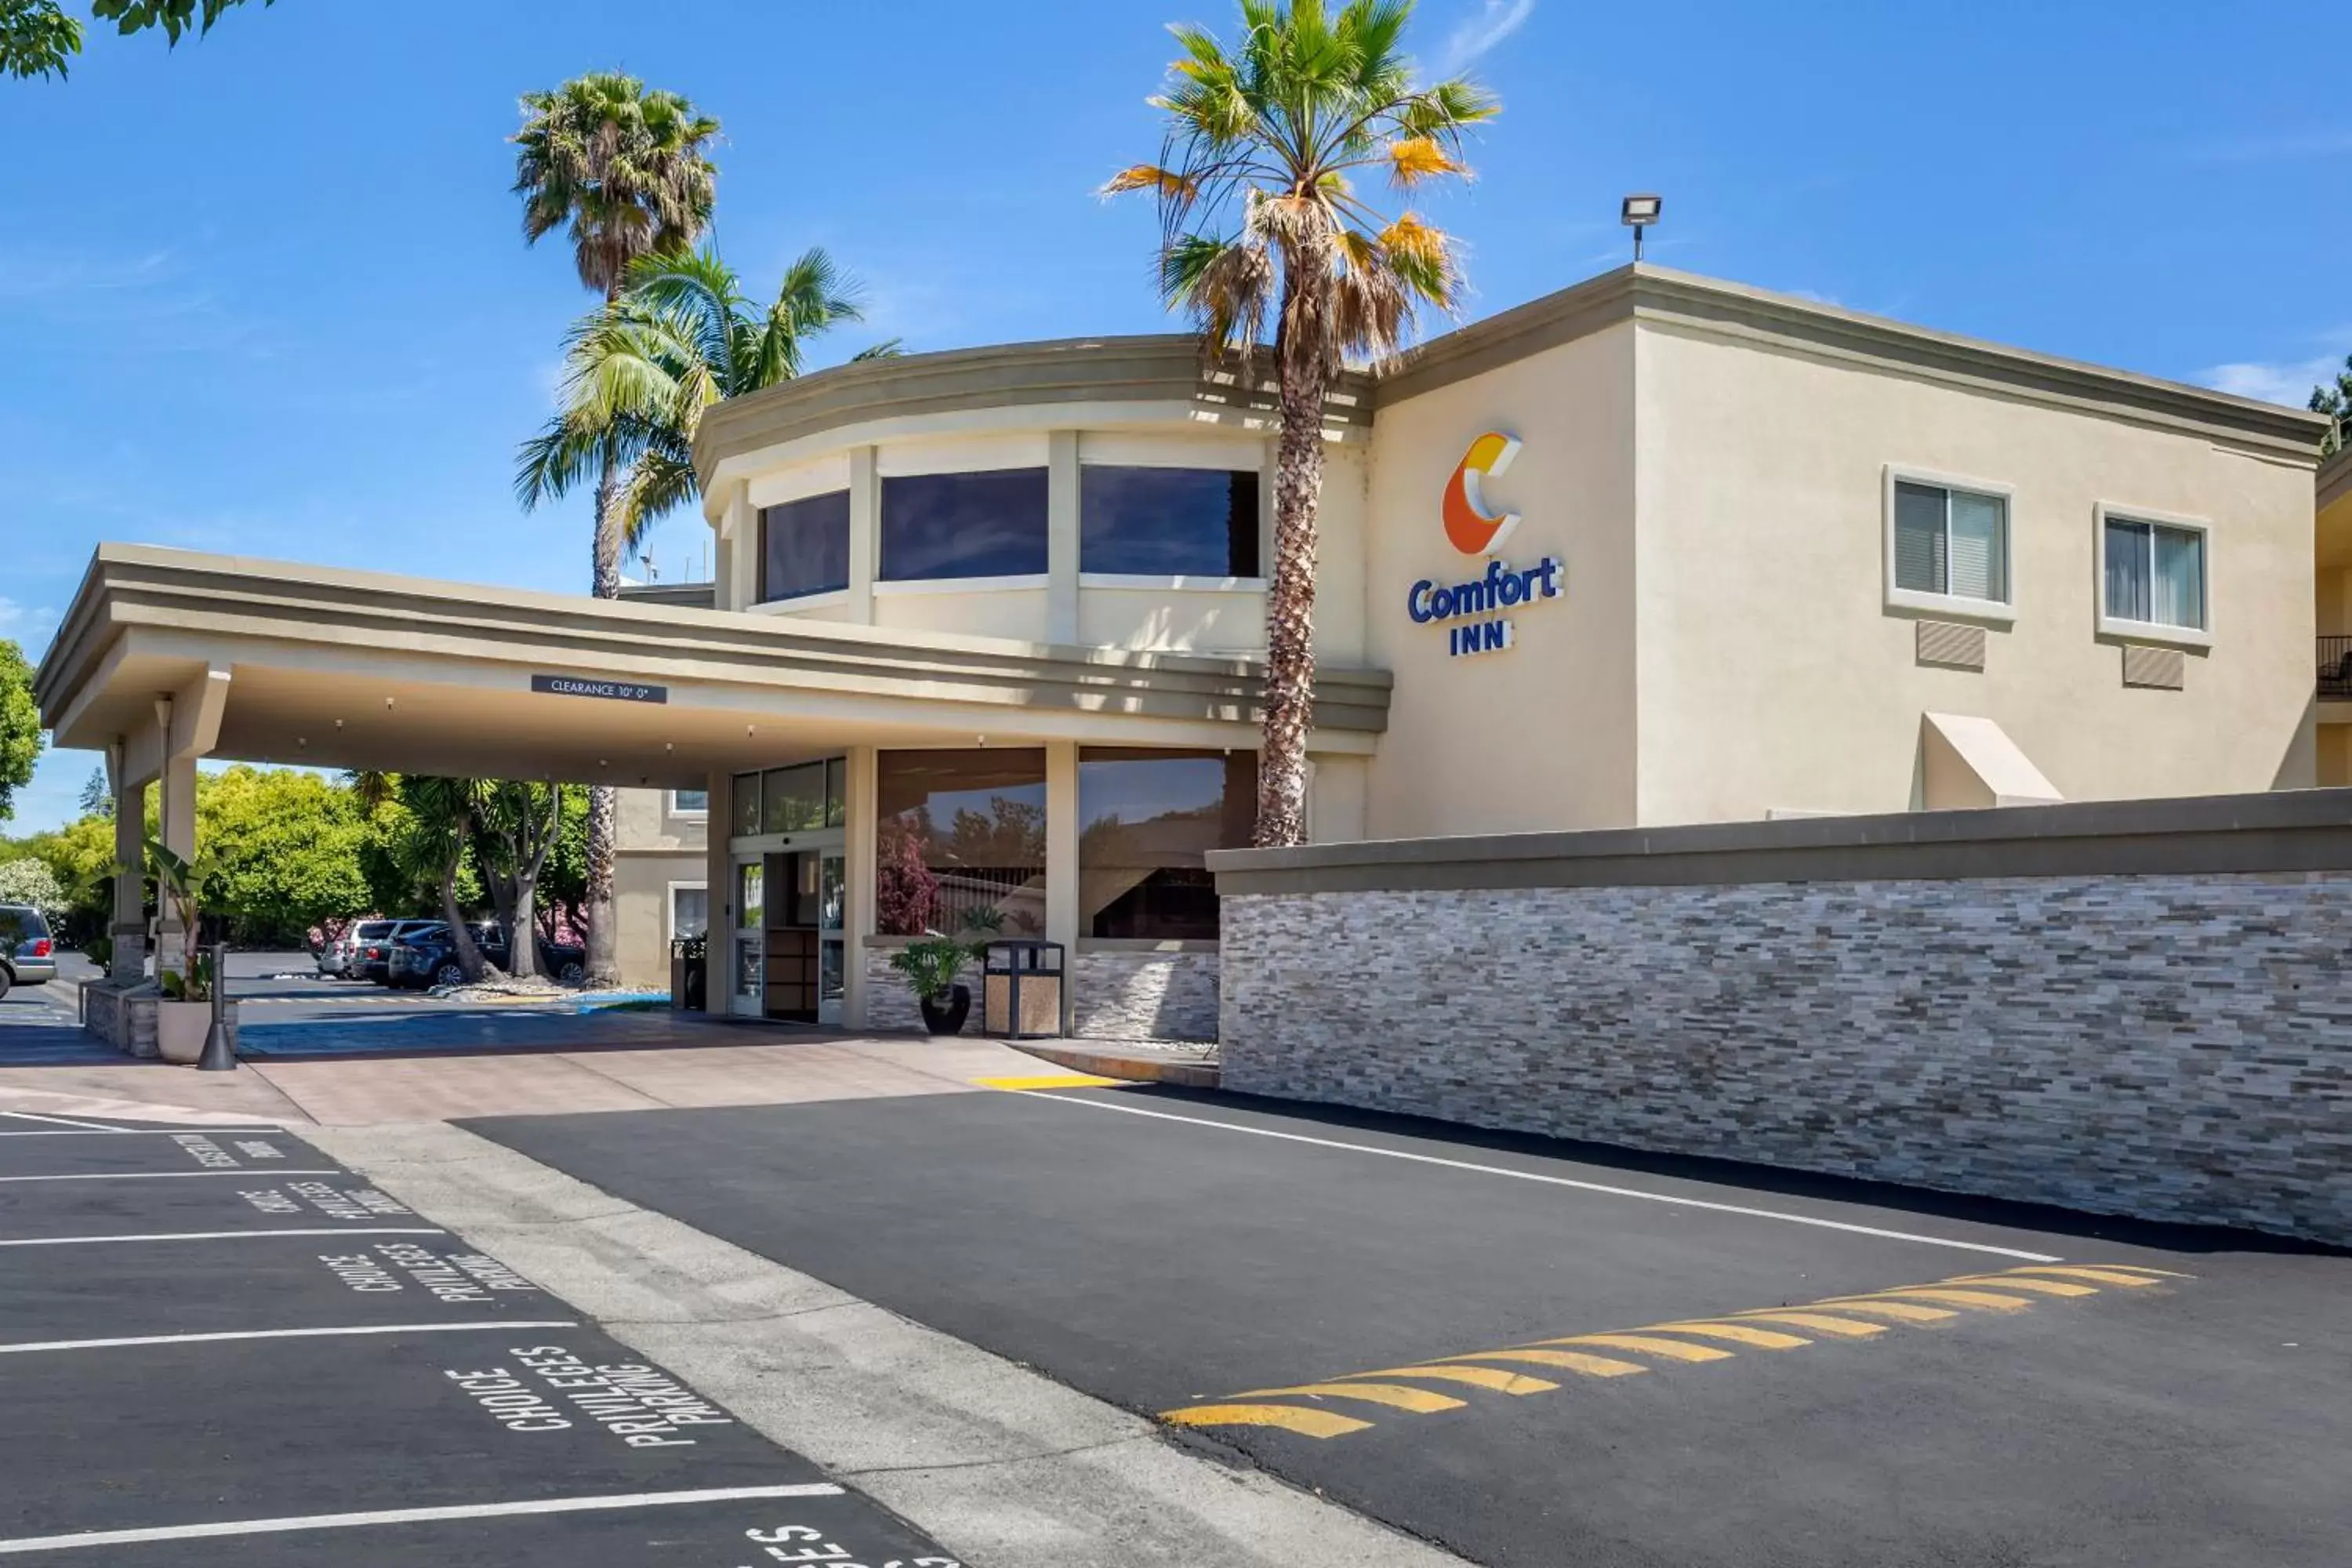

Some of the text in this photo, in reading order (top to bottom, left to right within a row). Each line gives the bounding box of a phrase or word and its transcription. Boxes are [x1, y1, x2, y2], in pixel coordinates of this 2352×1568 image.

[1408, 557, 1560, 625] Comfort
[1450, 619, 1508, 657] INN
[551, 680, 614, 695] CLEARANCE
[318, 1254, 404, 1291] CHOICE
[443, 1368, 573, 1432] CHOICE
[510, 1345, 697, 1448] PRIVILEGES
[595, 1364, 733, 1425] PARKING
